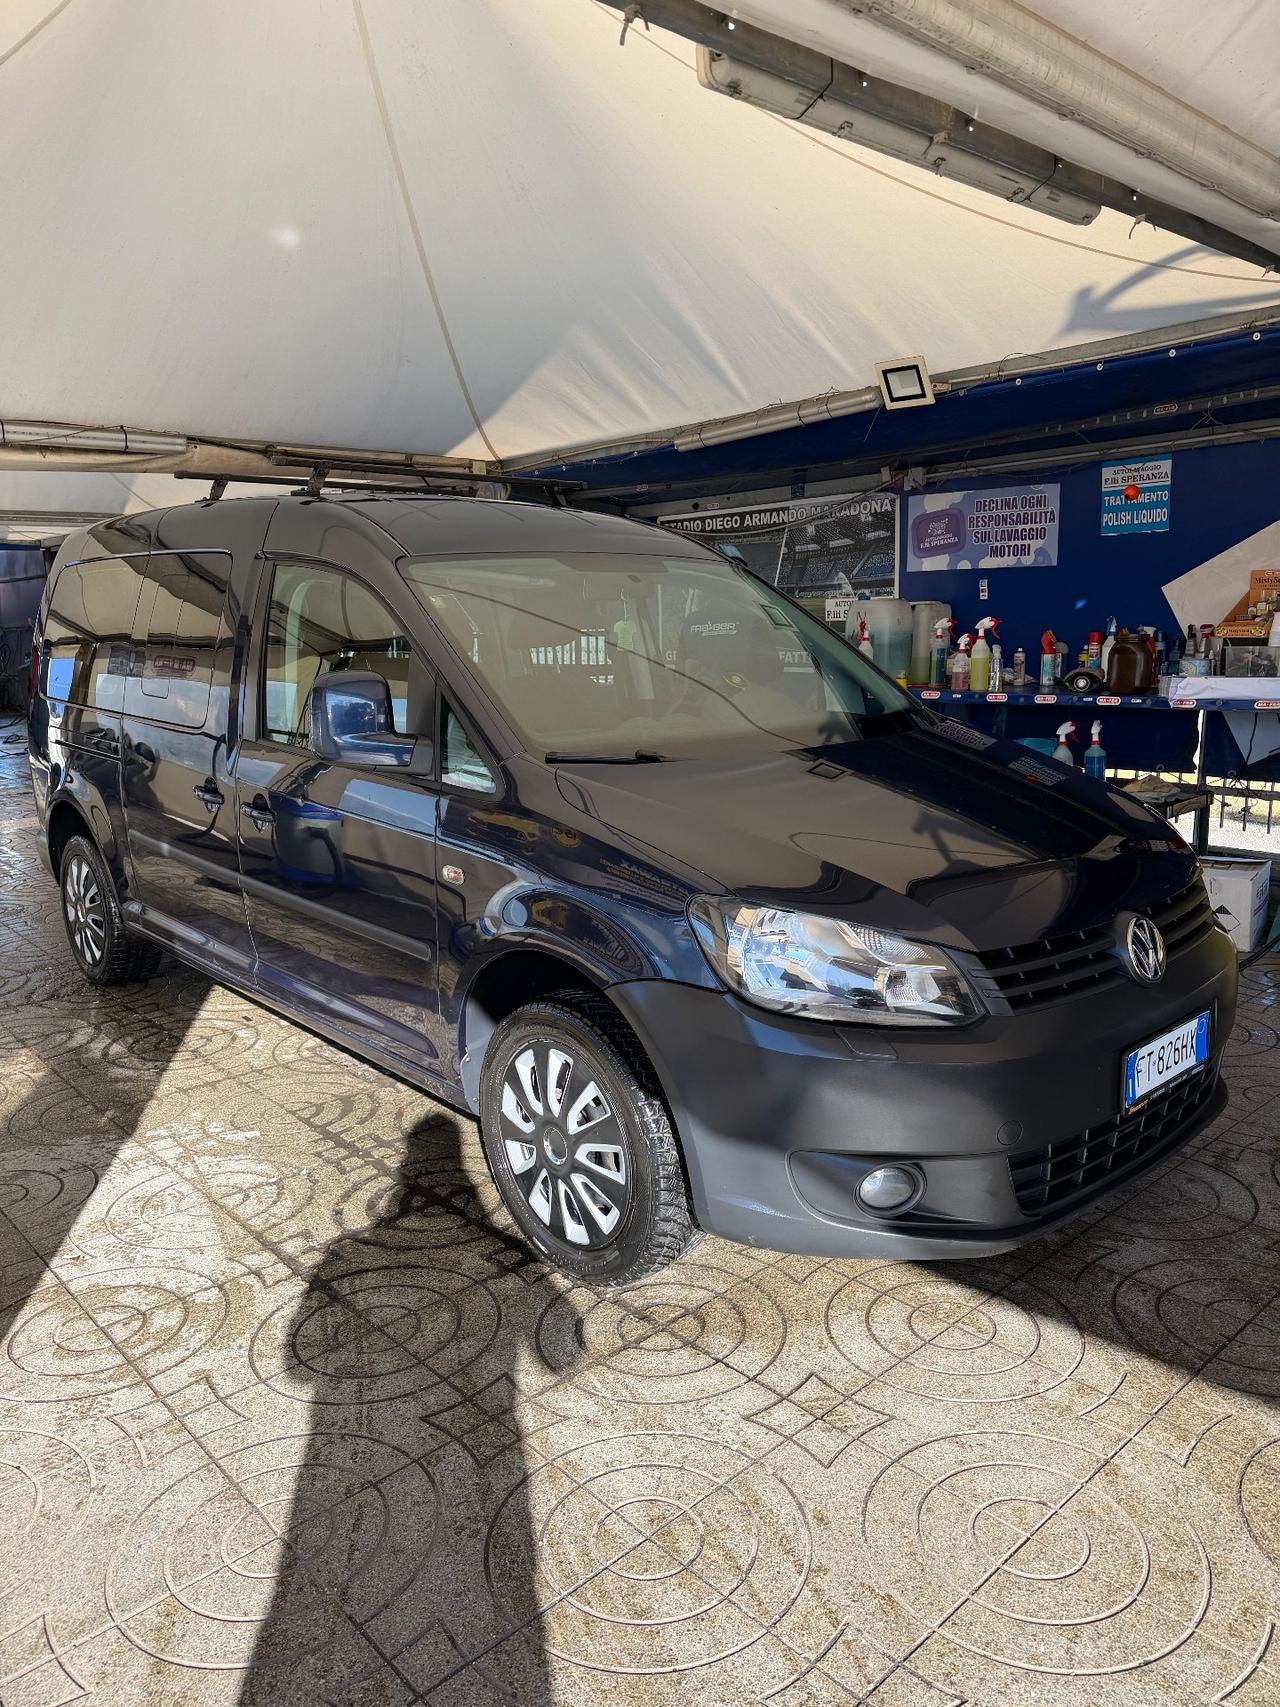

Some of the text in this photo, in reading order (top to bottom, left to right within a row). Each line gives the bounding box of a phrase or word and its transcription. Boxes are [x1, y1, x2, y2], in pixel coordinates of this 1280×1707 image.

[1121, 471, 1169, 483] SPERANZA
[976, 494, 1048, 512] DECLINA OGNI
[664, 520, 702, 531] ADIO
[705, 516, 740, 531] DIEGO
[744, 508, 806, 527] ARMANDO
[968, 508, 1056, 529] RESPONSABILITÀ
[1103, 508, 1168, 526] POLISH LIQUIDO
[973, 527, 1047, 544] SUL LAVAGGIO
[989, 544, 1031, 558] MOTORI
